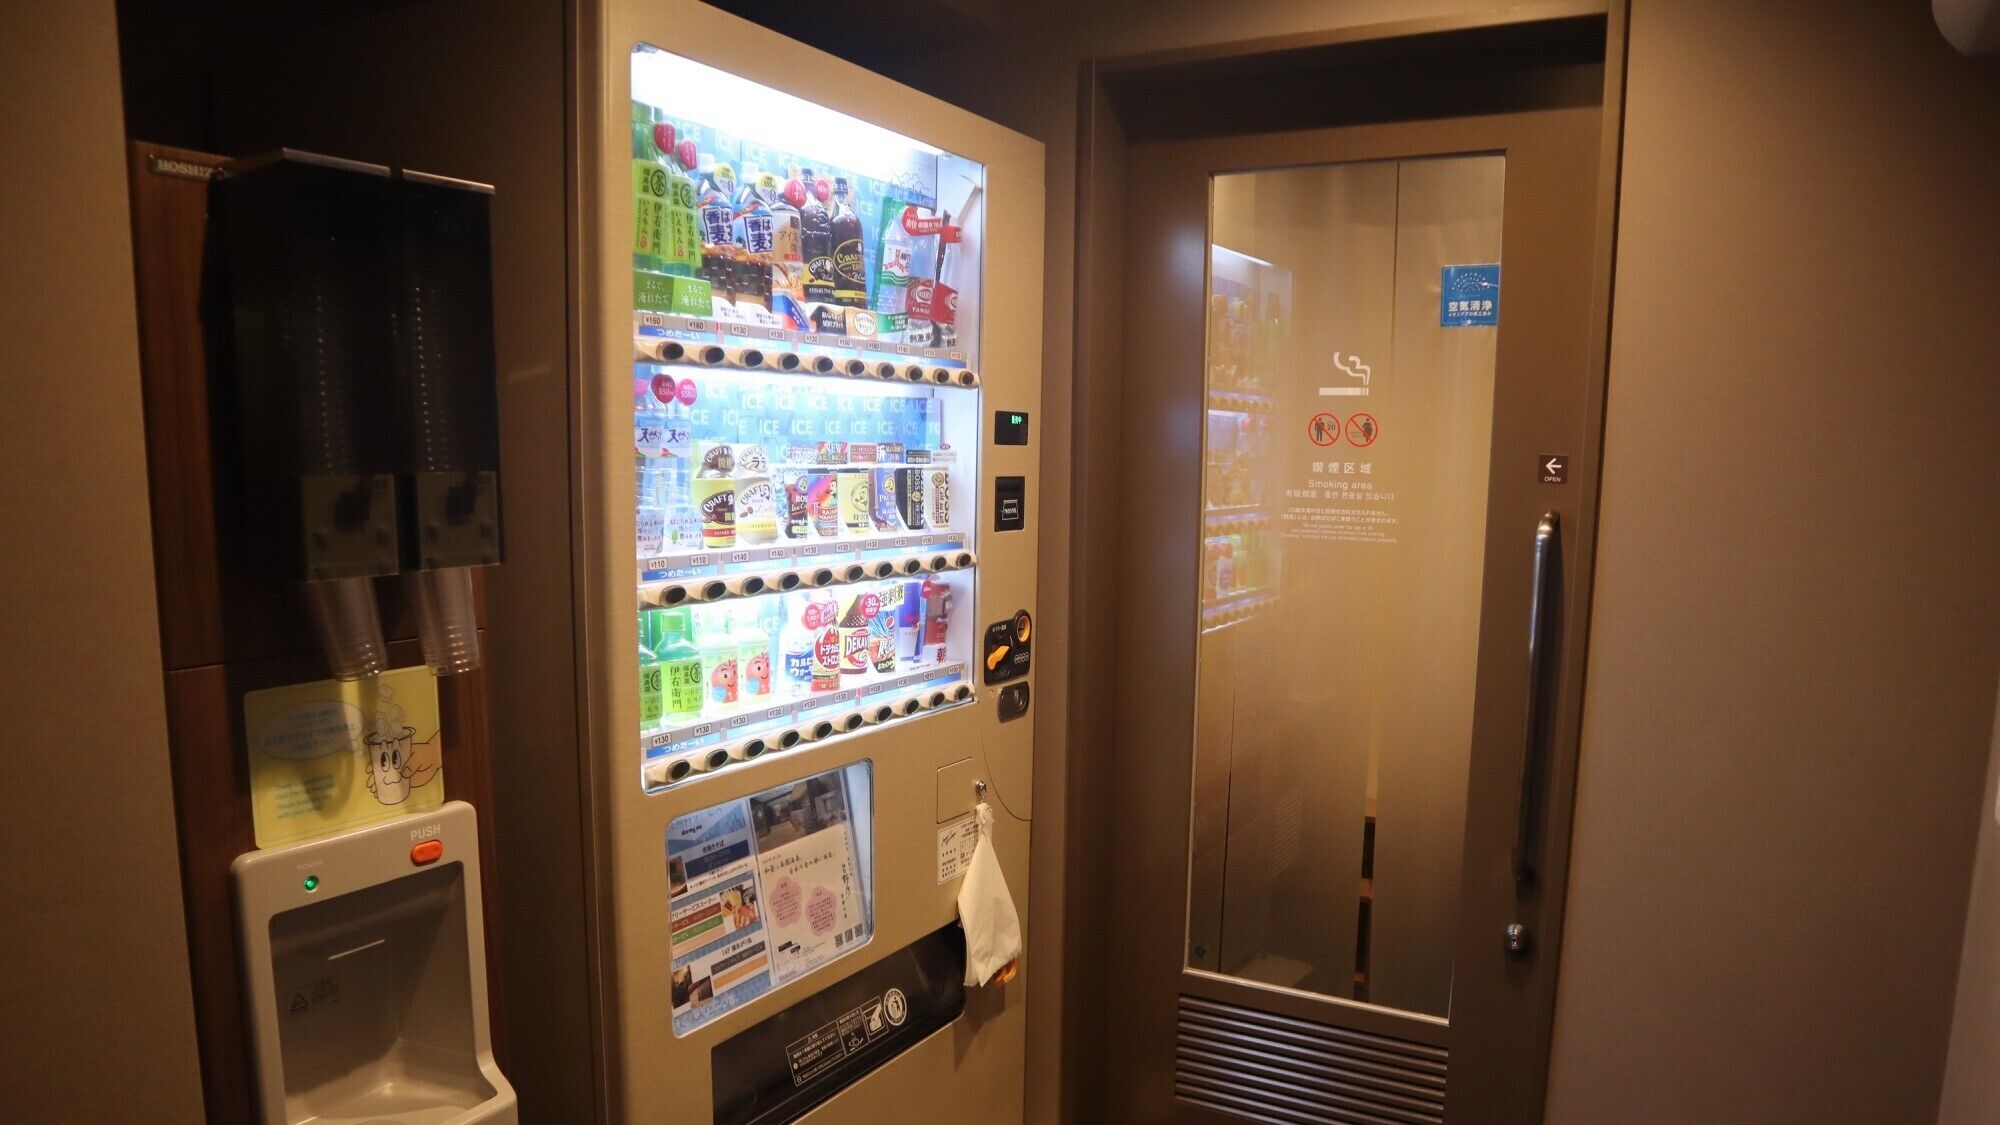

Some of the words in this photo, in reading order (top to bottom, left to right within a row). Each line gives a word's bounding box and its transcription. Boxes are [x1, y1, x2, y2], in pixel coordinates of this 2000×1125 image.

[733, 326, 747, 335] ¥130
[770, 330, 784, 339] ¥130
[1312, 461, 1372, 474] 喫煙区域
[1308, 479, 1348, 491] Smoking
[1351, 482, 1372, 490] area
[703, 493, 728, 512] CRAFT
[734, 552, 747, 561] ¥140
[650, 560, 665, 569] ¥110
[670, 666, 683, 710] 伊右衛門
[803, 700, 815, 708] ¥130
[769, 708, 782, 716] ¥130
[733, 717, 746, 726] ¥130
[696, 725, 710, 734] ¥130
[655, 735, 669, 744] ¥130
[410, 823, 441, 841] PUSH
